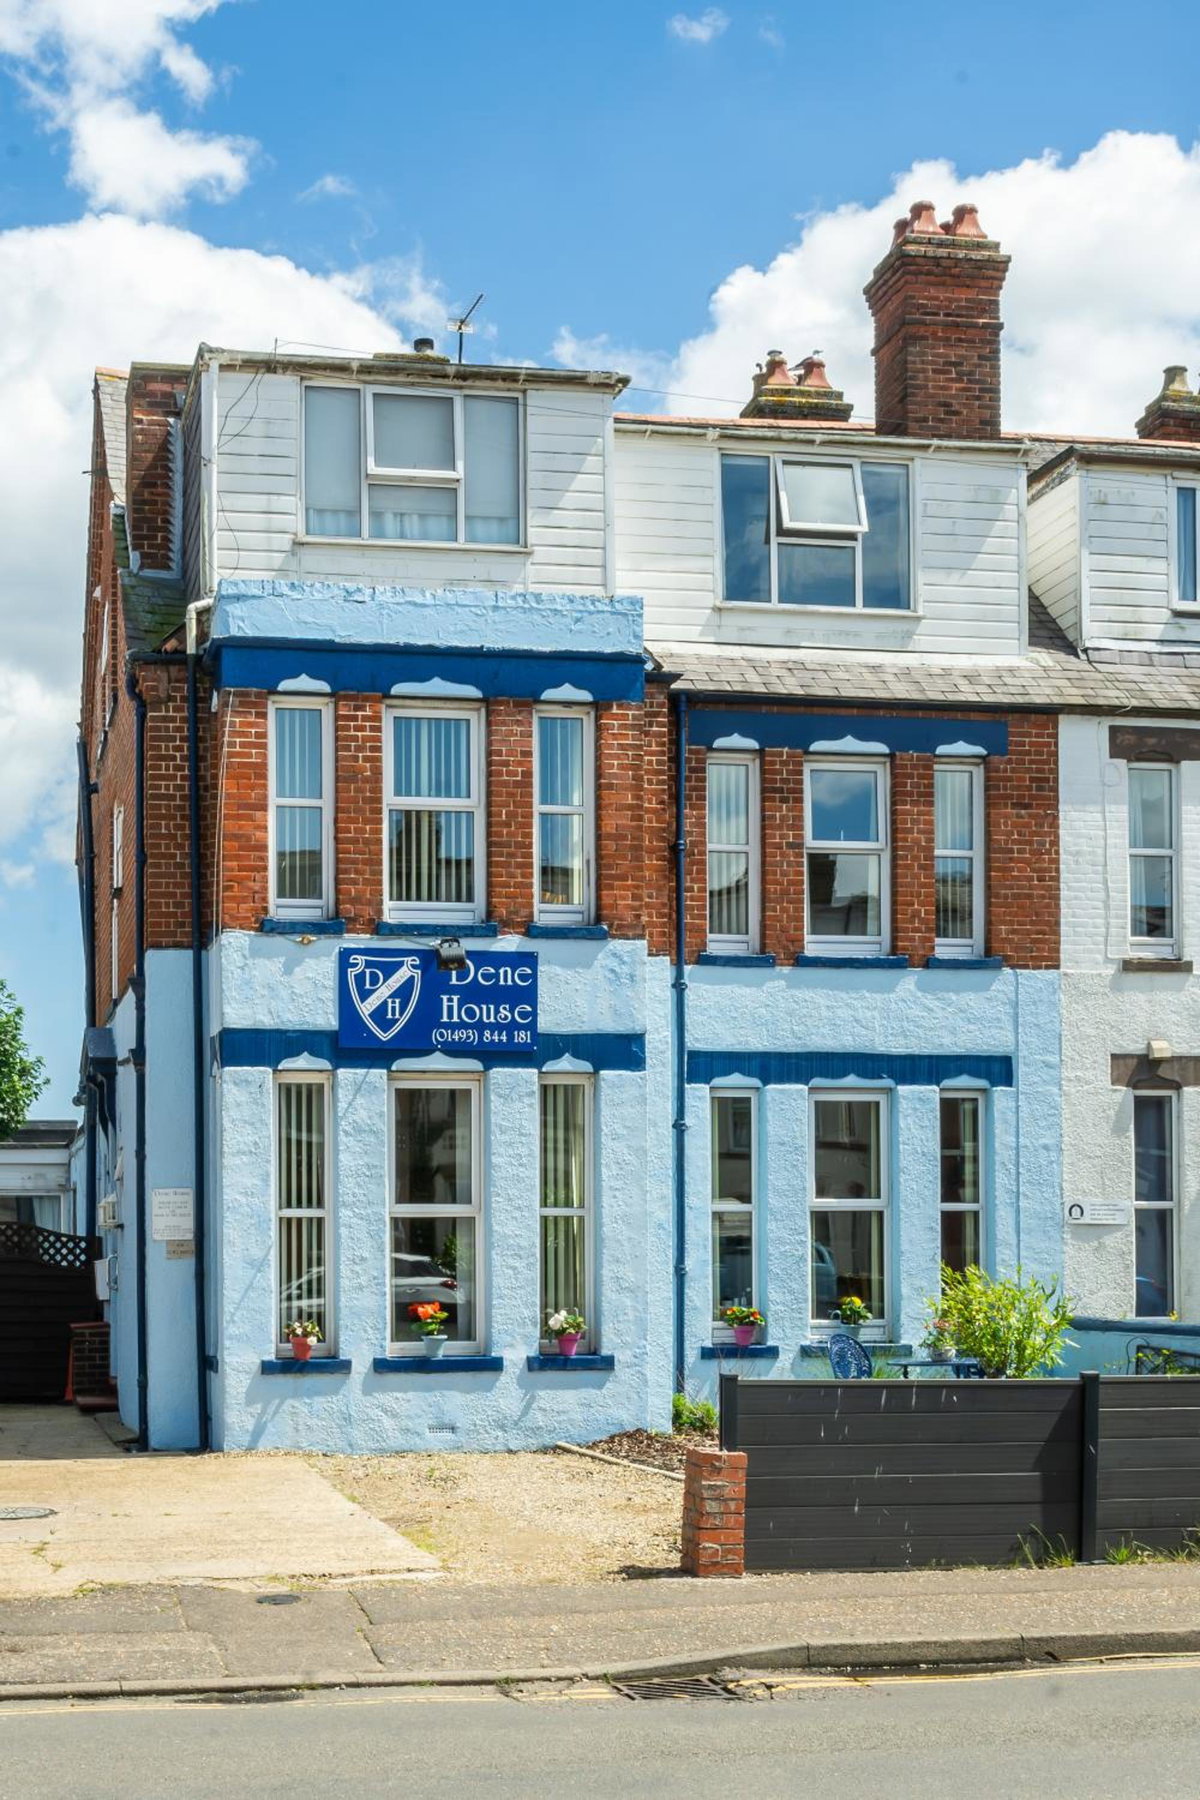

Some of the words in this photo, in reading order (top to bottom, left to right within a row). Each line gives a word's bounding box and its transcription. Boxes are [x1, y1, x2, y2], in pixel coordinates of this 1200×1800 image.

[364, 968, 384, 990] D
[449, 958, 532, 986] Dene
[386, 998, 401, 1019] H
[440, 994, 533, 1023] House
[432, 1028, 479, 1046] (01493)
[483, 1030, 508, 1043] 844
[514, 1030, 531, 1043] 181
